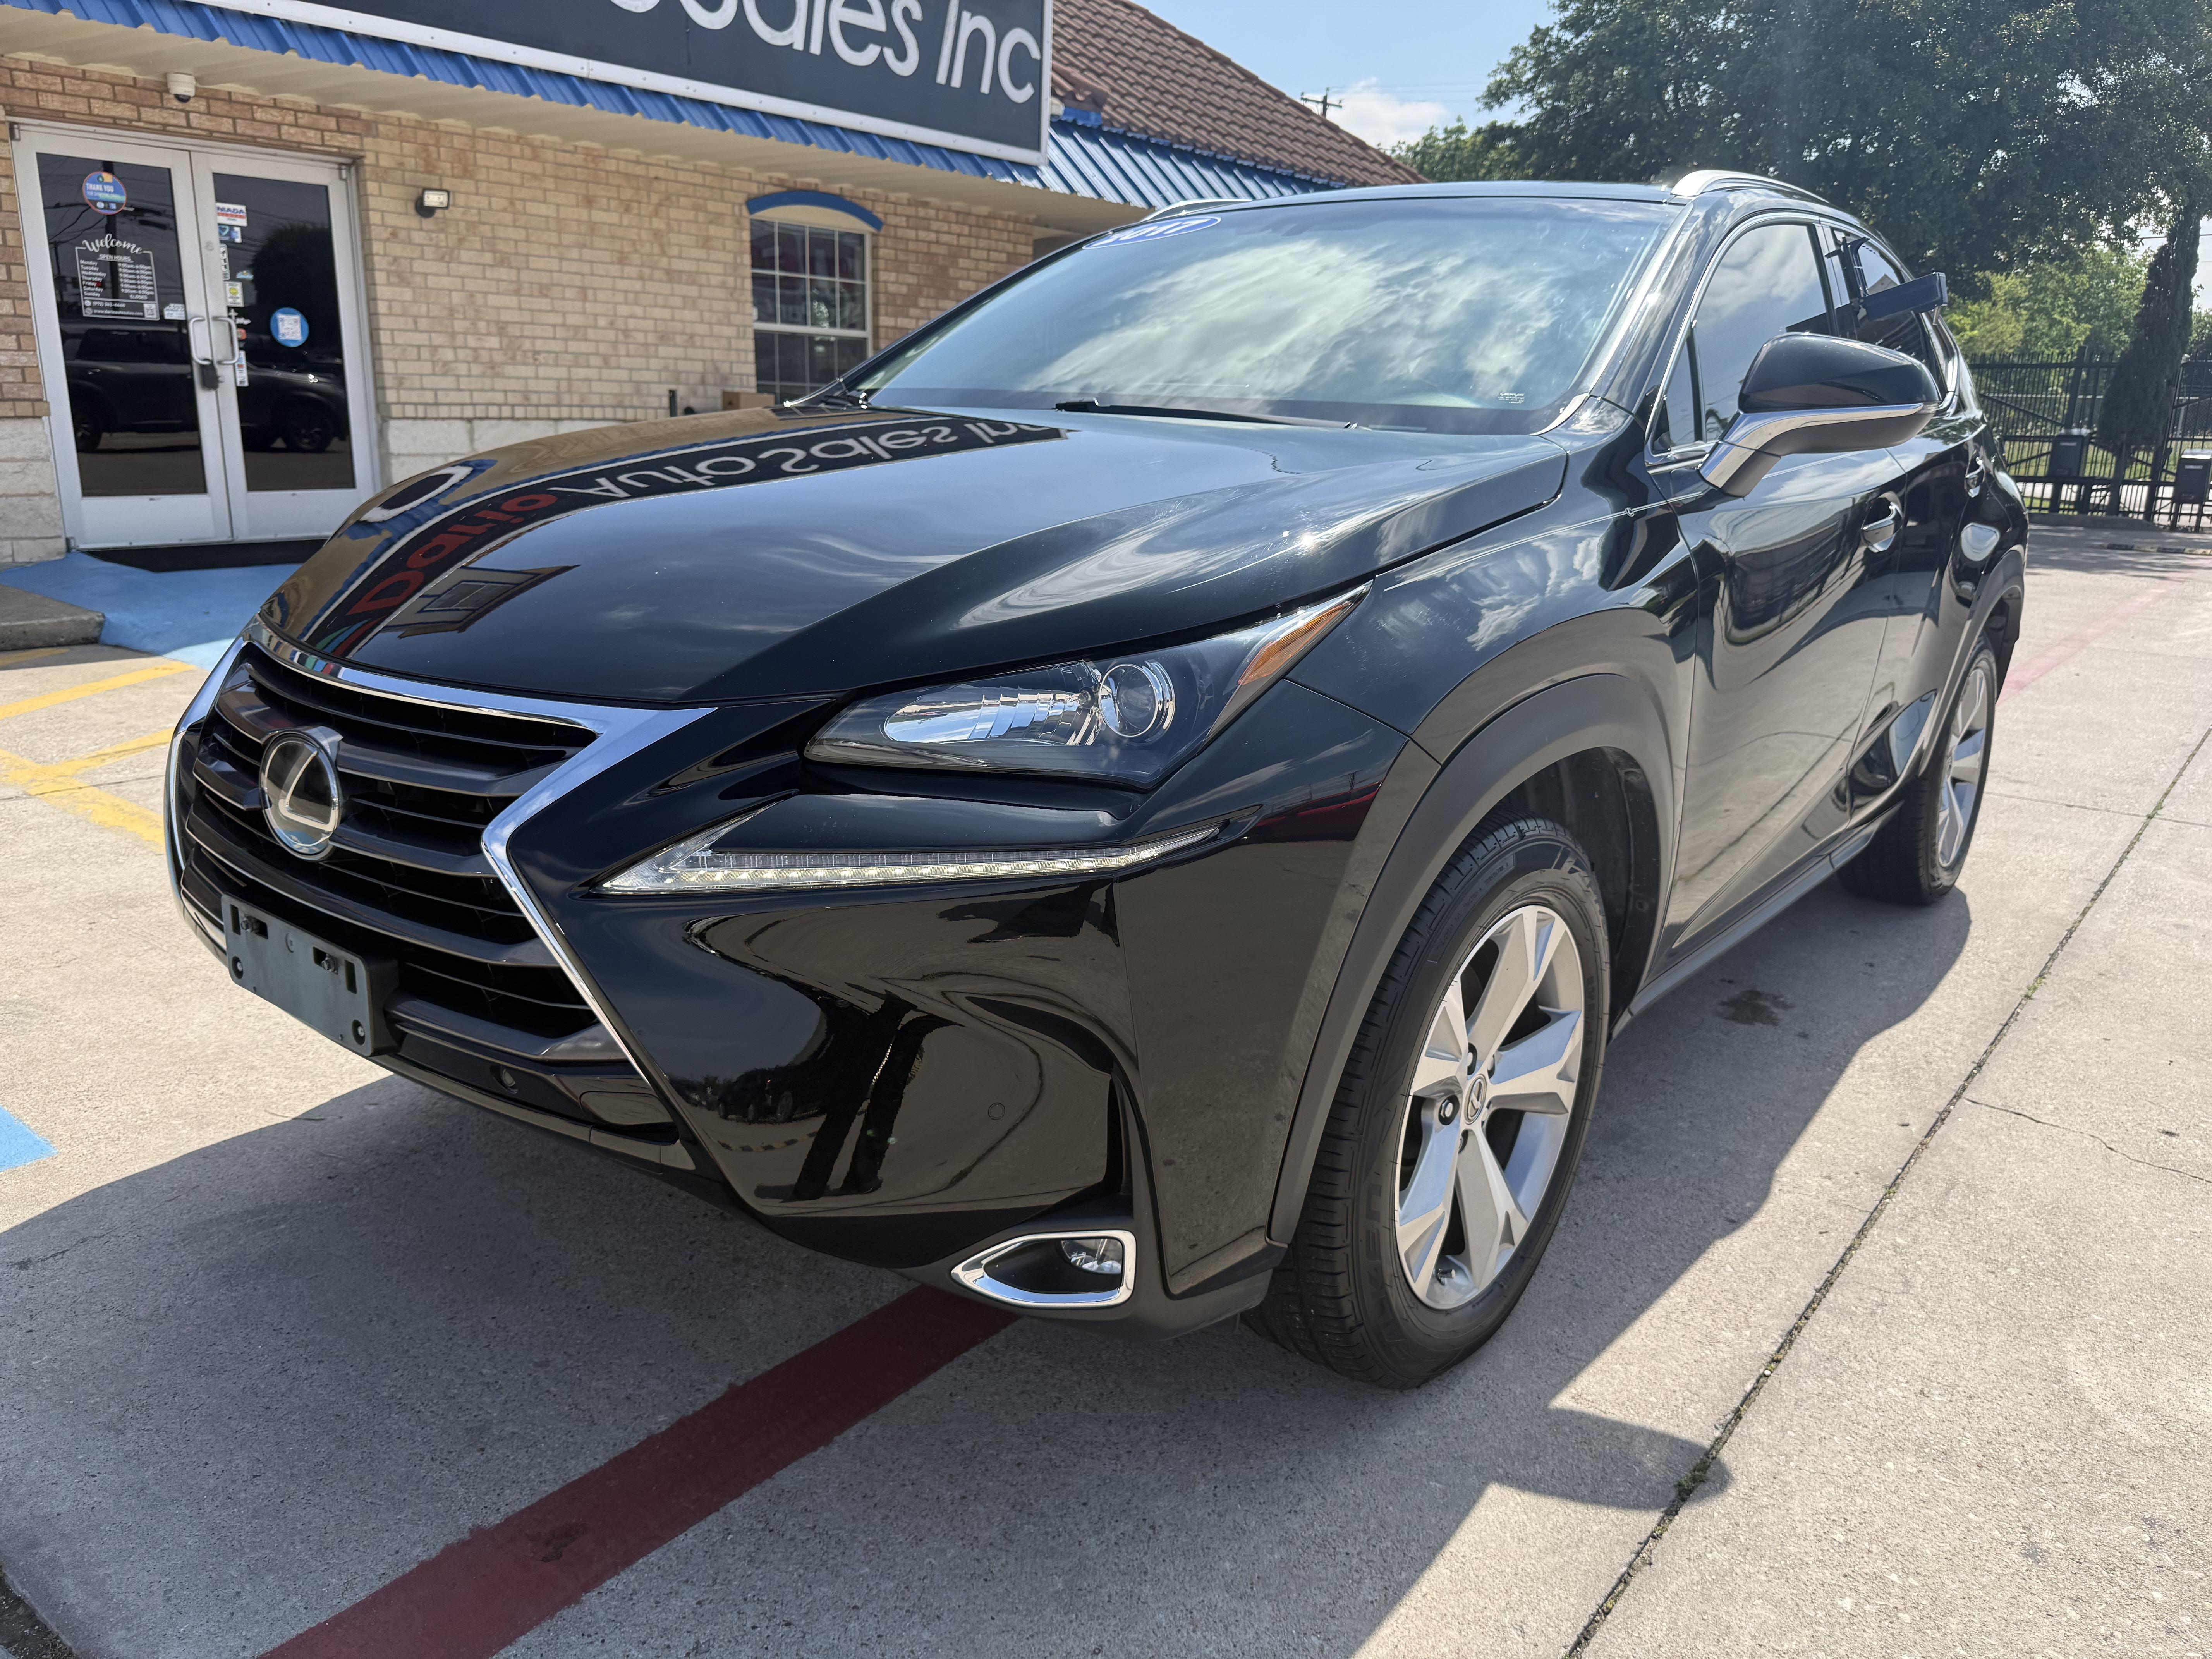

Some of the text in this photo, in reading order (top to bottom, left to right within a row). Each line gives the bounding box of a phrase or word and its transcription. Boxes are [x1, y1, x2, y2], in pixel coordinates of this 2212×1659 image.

[936, 0, 1041, 103] Inc
[82, 233, 143, 254] Welcome
[81, 270, 107, 278] Wednesday
